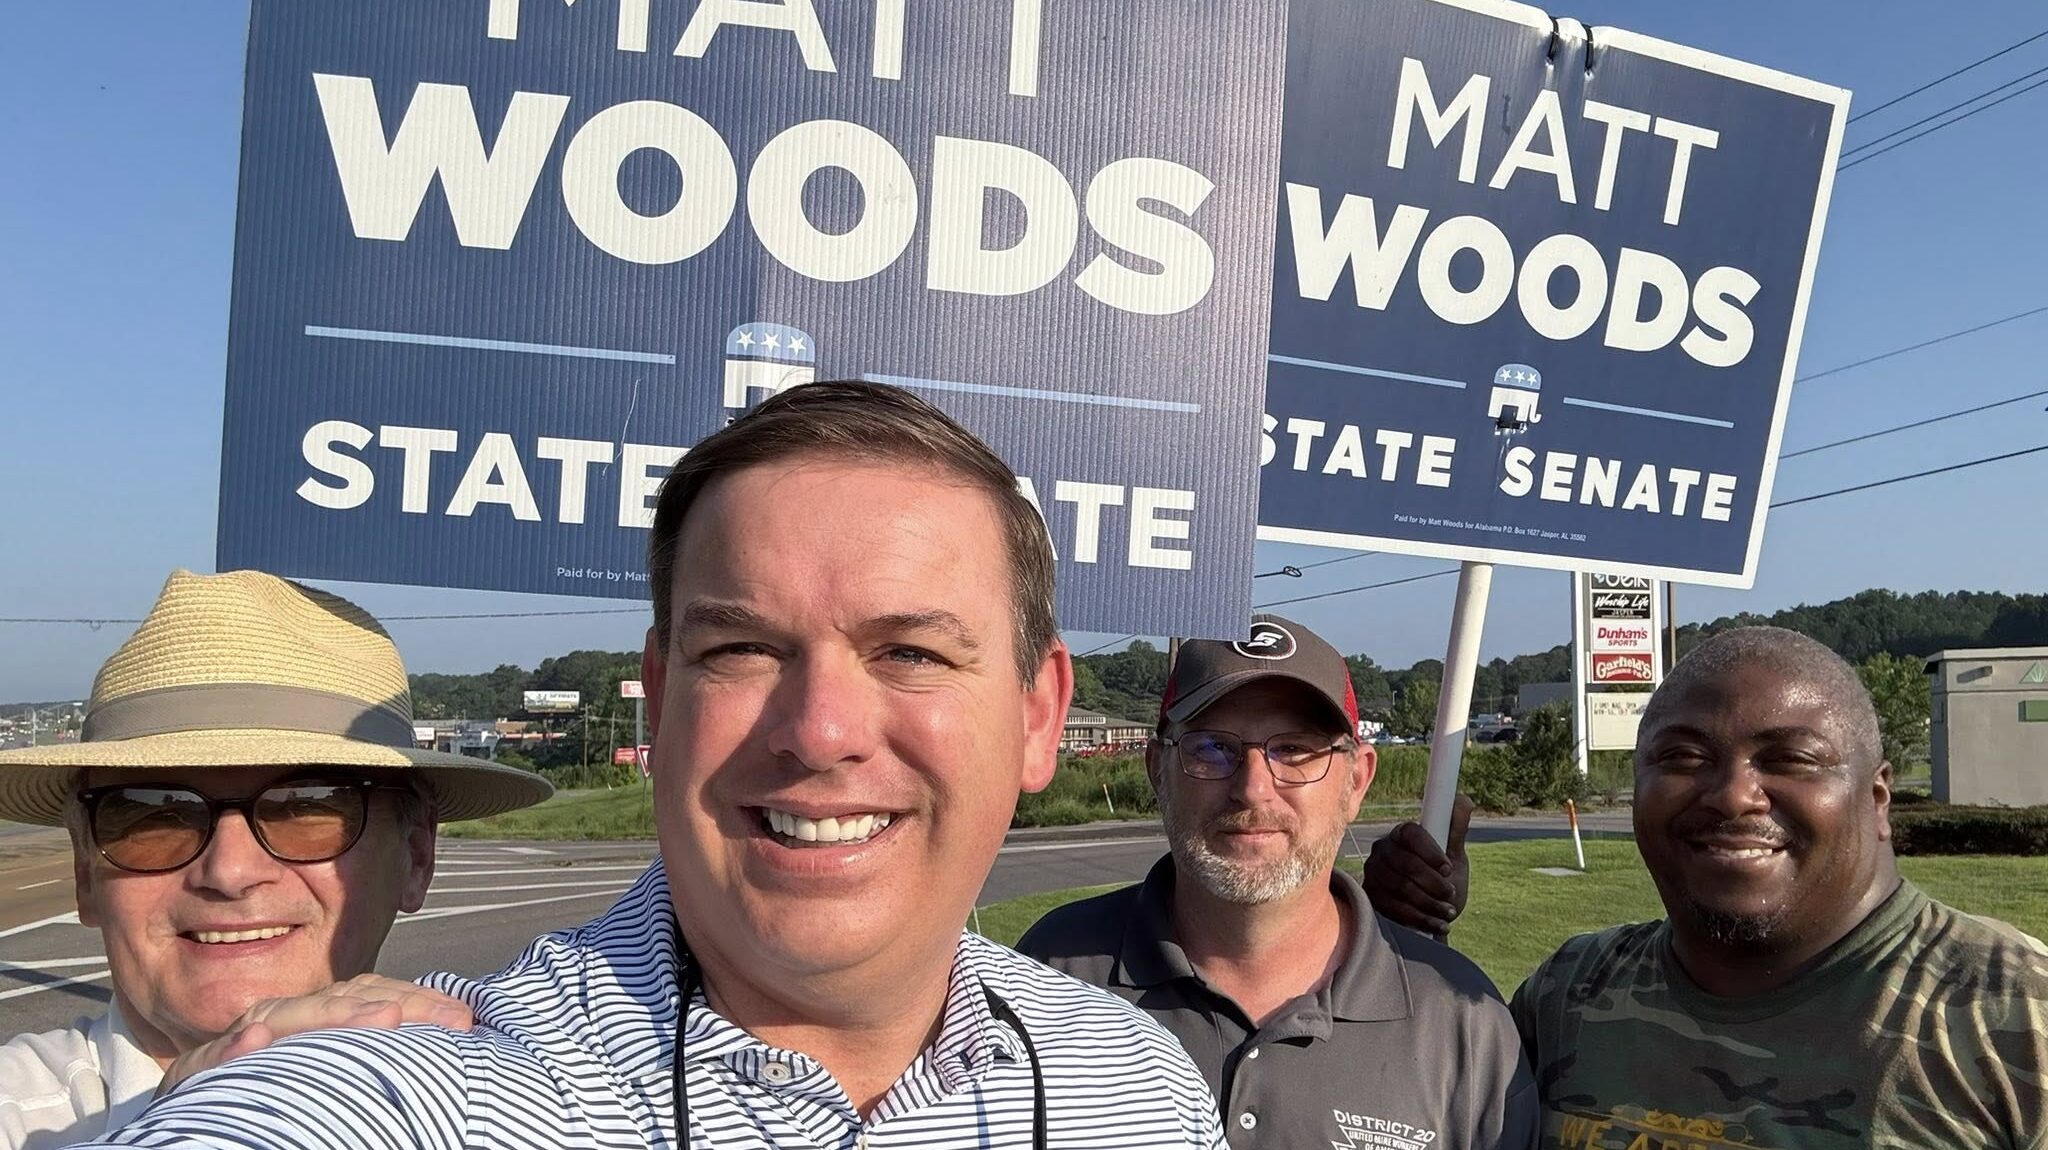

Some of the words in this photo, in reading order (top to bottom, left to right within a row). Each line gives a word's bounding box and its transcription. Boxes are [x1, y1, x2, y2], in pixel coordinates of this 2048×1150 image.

[1387, 56, 1720, 226] MATT
[312, 72, 1216, 315] WOODS
[1285, 181, 1762, 367] WOODS
[296, 420, 692, 529] STATE
[1260, 412, 1457, 488] STATE
[1499, 446, 1738, 522] SENATE
[1394, 514, 1408, 522] Paid
[1420, 517, 1427, 525] by
[1428, 518, 1441, 526] Matt
[1443, 520, 1464, 528] Woods
[1474, 523, 1502, 533] Alabama
[1514, 527, 1526, 535] Box
[1560, 532, 1569, 540] AL
[557, 567, 583, 578] Paid
[586, 569, 604, 579] for
[606, 570, 622, 582] by
[1594, 593, 1630, 608] Worship
[1631, 594, 1649, 610] Life
[1597, 626, 1648, 640] Dunham's
[1333, 1109, 1414, 1138] DISTRICT
[1413, 1129, 1436, 1143] 20
[1349, 1130, 1374, 1143] UNITED
